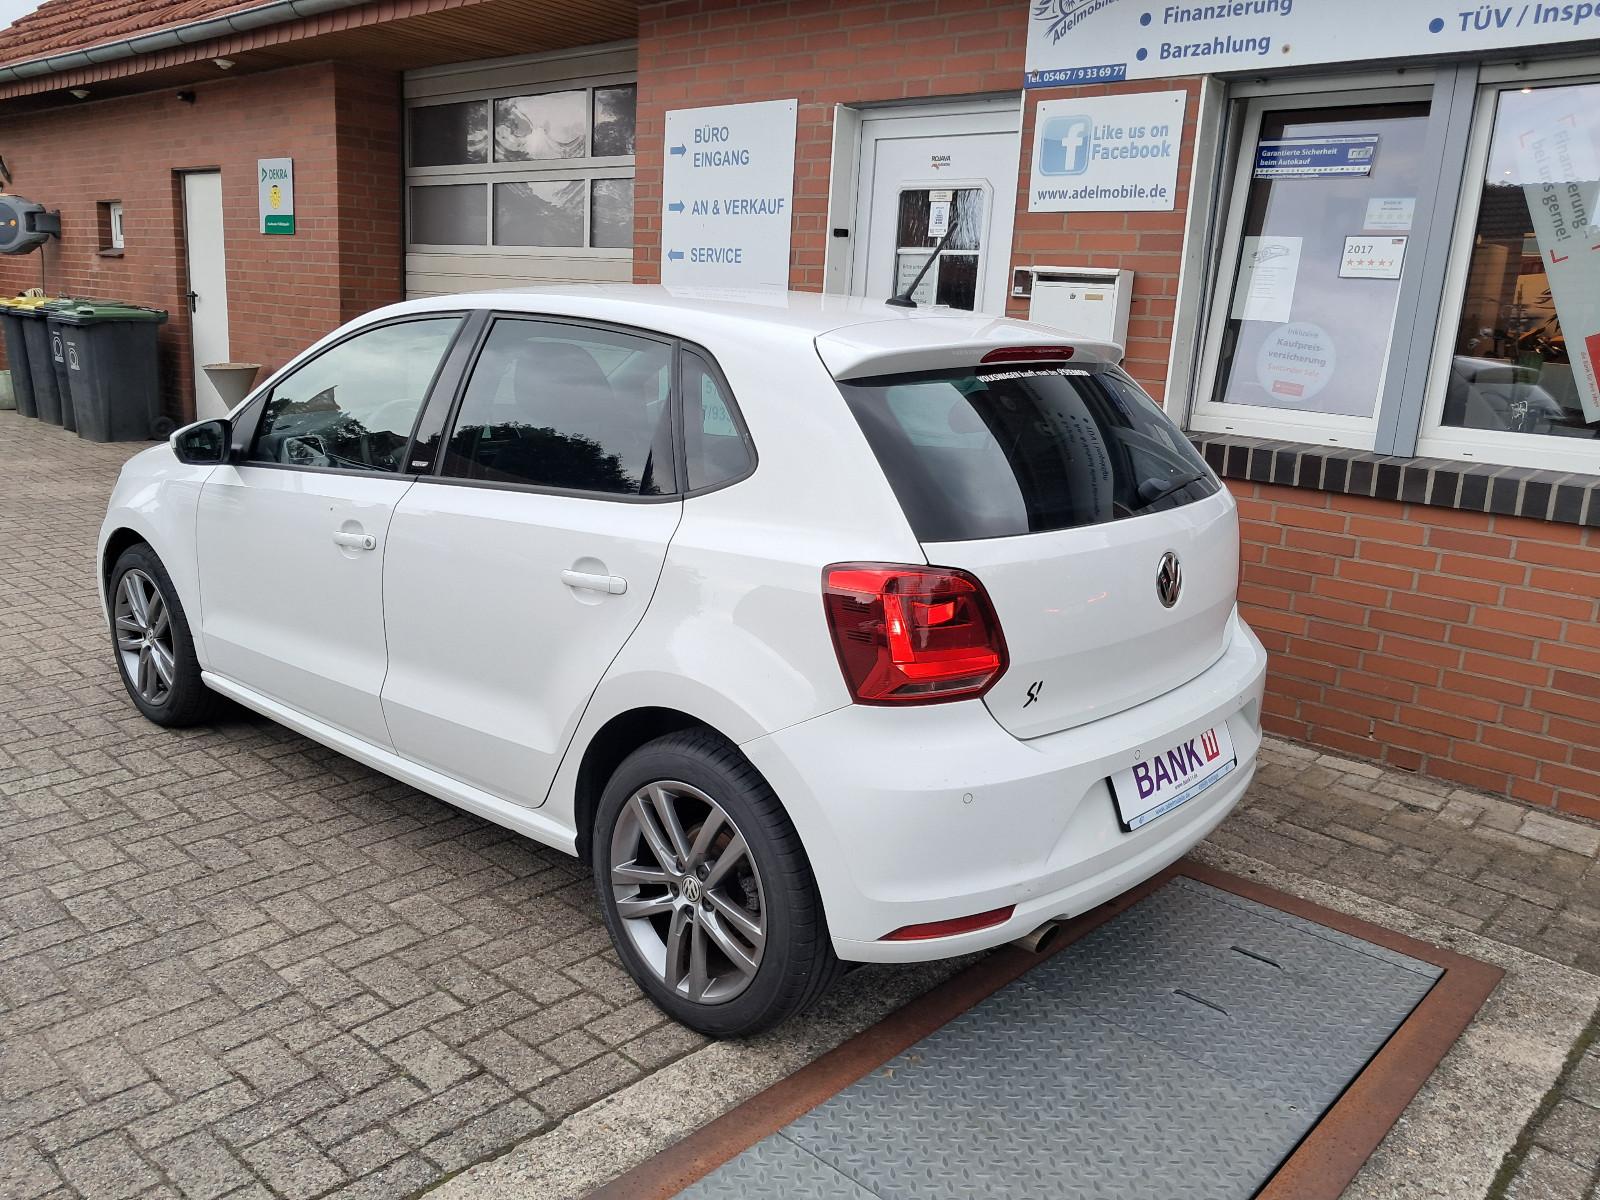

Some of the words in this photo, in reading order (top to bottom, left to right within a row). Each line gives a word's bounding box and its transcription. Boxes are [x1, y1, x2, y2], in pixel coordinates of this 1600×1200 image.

[1163, 0, 1293, 24] Finanzierung
[1458, 5, 1513, 31] TÜV
[1160, 36, 1271, 60] Barzahlung
[1044, 70, 1071, 82] 05467
[1085, 68, 1097, 78] 33
[1099, 67, 1111, 77] 69
[1113, 66, 1125, 76] 77
[694, 124, 729, 144] BÜRO
[1093, 124, 1123, 141] Like
[1128, 126, 1146, 139] us
[1150, 124, 1168, 138] on
[693, 149, 750, 168] EINGANG
[1091, 140, 1171, 160] Facebook
[1261, 149, 1300, 157] Garantierte
[1301, 148, 1337, 156] Sicherheit
[1260, 158, 1277, 166] beim
[1278, 157, 1311, 166] Autokauf
[268, 168, 288, 180] DEKRA
[1037, 184, 1167, 201] www.adelmobile.de
[691, 199, 709, 215] AN
[711, 199, 720, 215] &
[724, 198, 785, 215] VERKAUF
[1542, 195, 1572, 242] gerne!
[690, 247, 742, 264] SERVICE
[1347, 245, 1374, 254] 2017
[1268, 351, 1327, 367] versicherung
[1131, 738, 1204, 800] BANK
